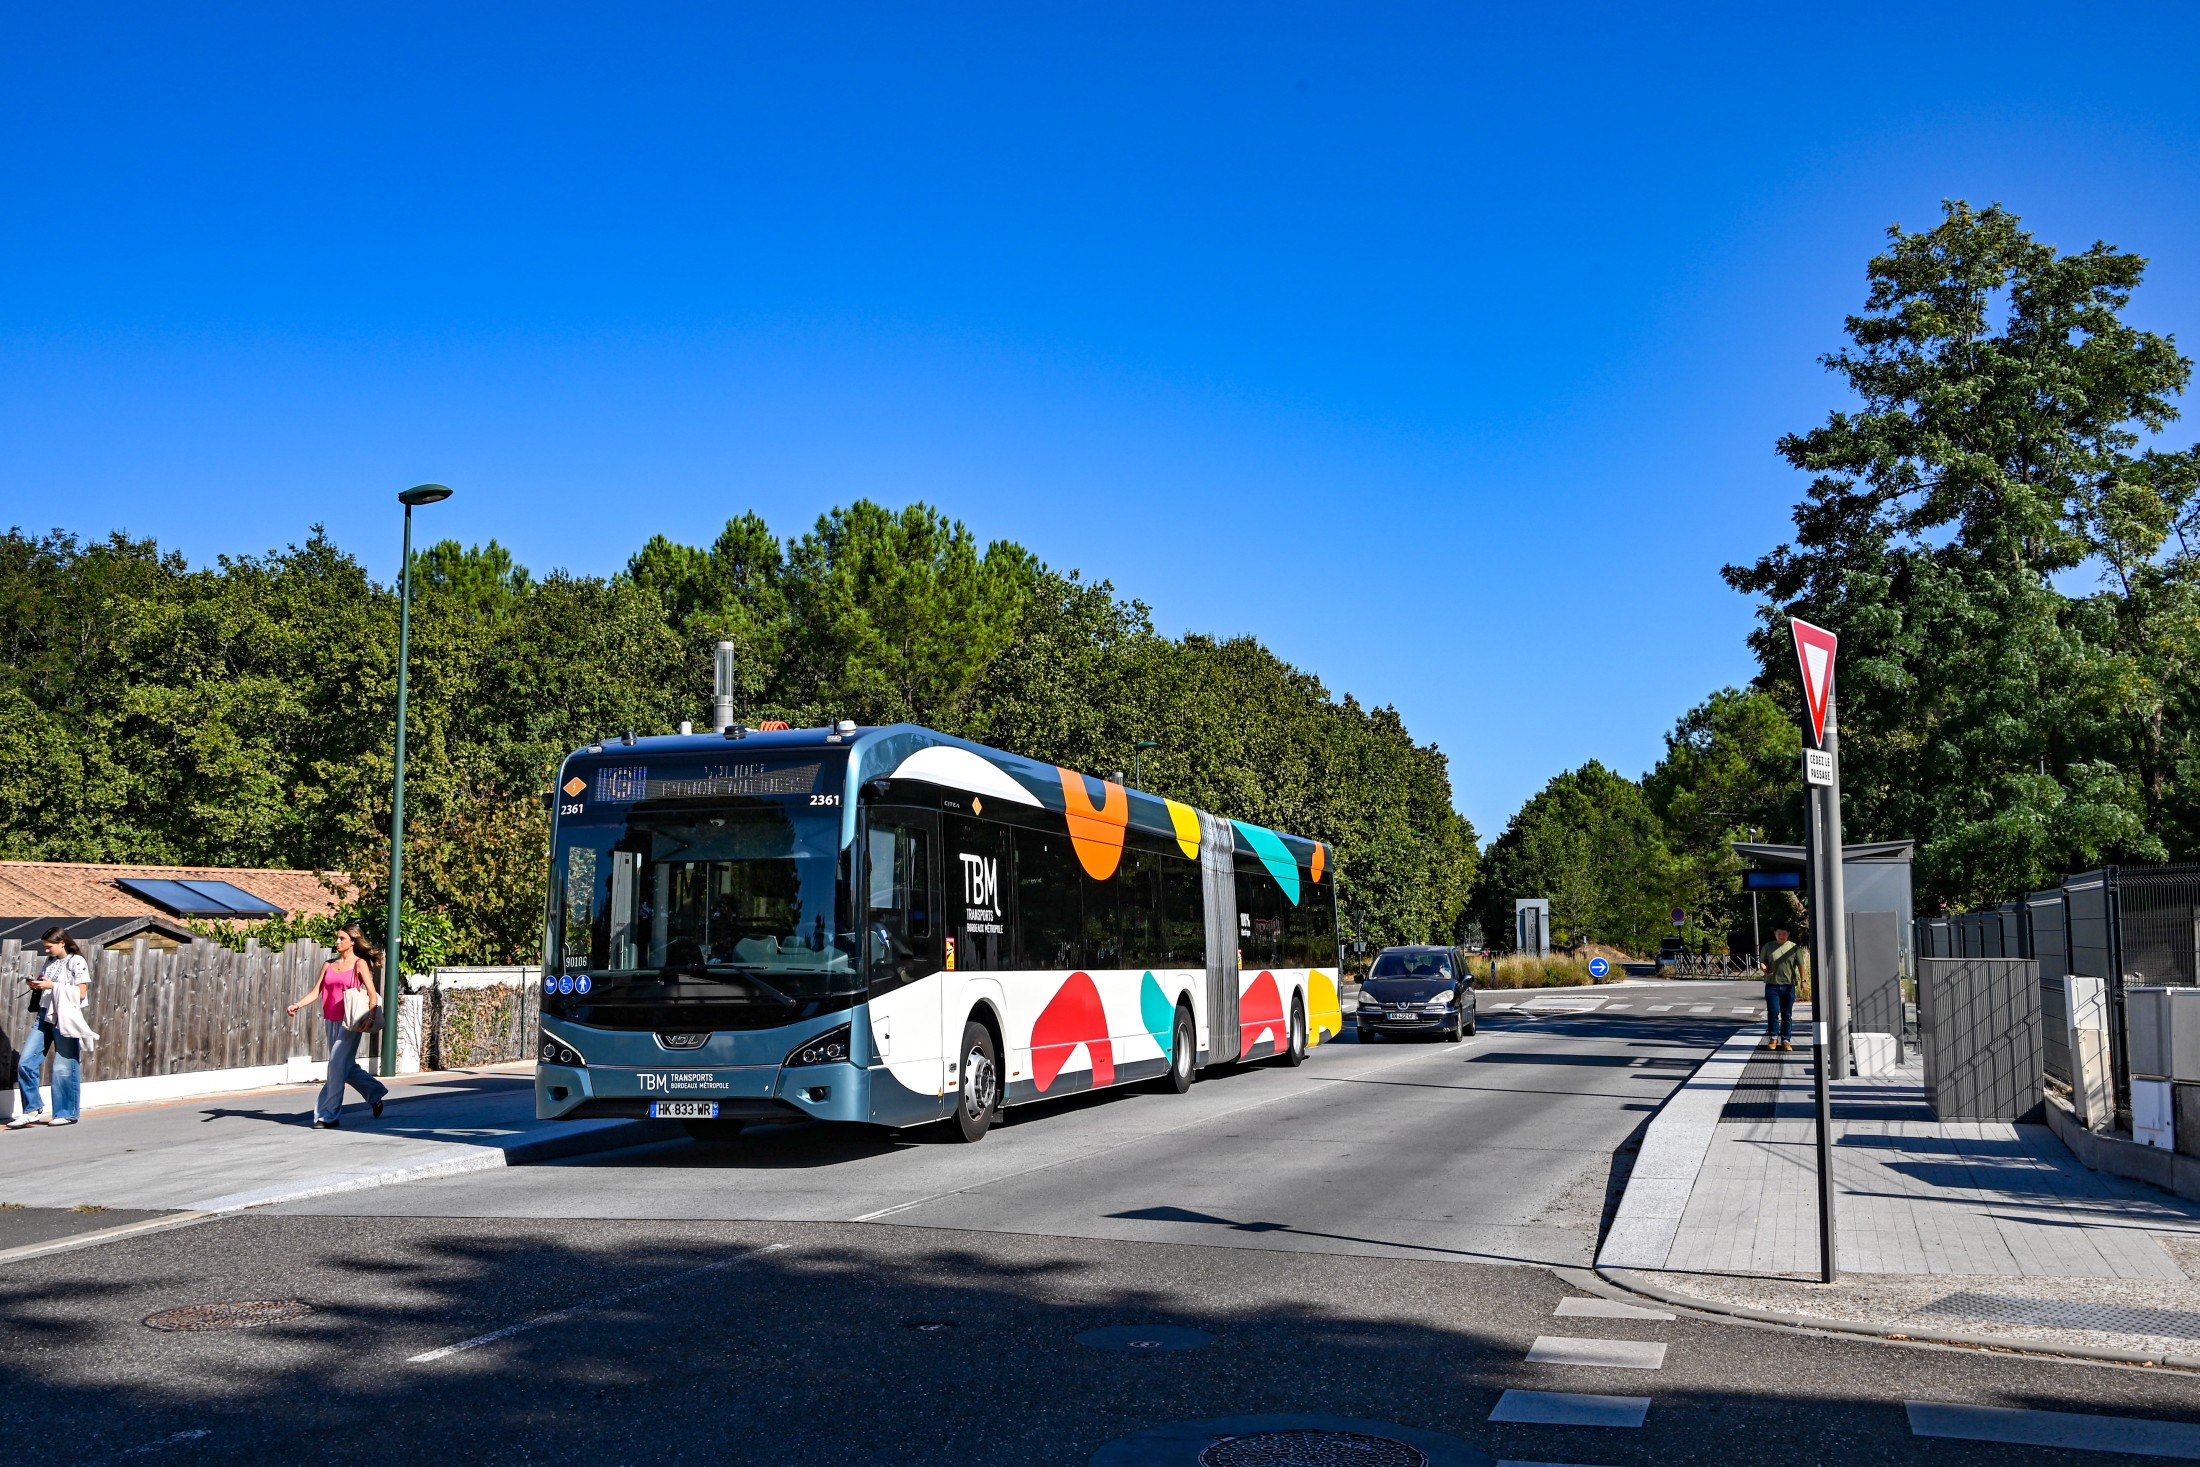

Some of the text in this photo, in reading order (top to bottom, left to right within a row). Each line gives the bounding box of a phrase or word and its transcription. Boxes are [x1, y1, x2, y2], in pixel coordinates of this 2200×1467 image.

[1825, 757, 1830, 766] LE
[1811, 769, 1831, 780] PASSAGE
[810, 794, 840, 806] 2361
[560, 804, 584, 816] 2361
[959, 852, 1001, 917] TBM
[966, 908, 994, 922] TRANSPORTS
[966, 922, 1004, 934] BORDEAUX MÉTROPOLE
[565, 956, 587, 967] 90106
[637, 1073, 669, 1093] TBM
[671, 1073, 713, 1081] TRANSPORTS
[658, 1104, 710, 1115] HK-833-WR
